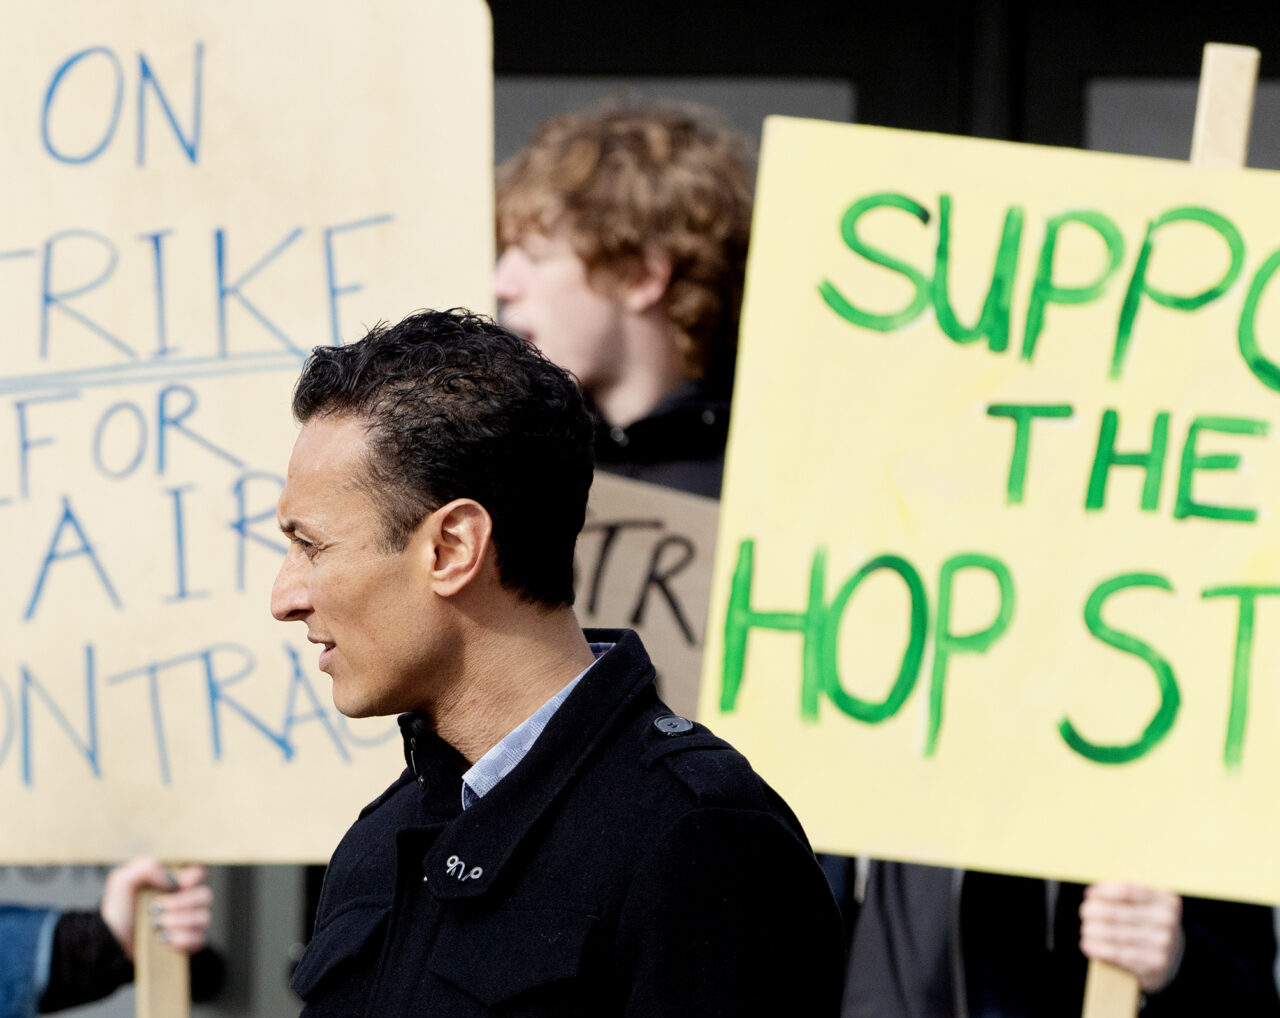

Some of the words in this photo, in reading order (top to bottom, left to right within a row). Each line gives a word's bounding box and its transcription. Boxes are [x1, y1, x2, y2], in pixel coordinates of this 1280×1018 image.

[38, 42, 204, 166] ON
[14, 383, 246, 500] FOR
[986, 402, 1271, 522] THE
[718, 537, 1018, 759] HOP
